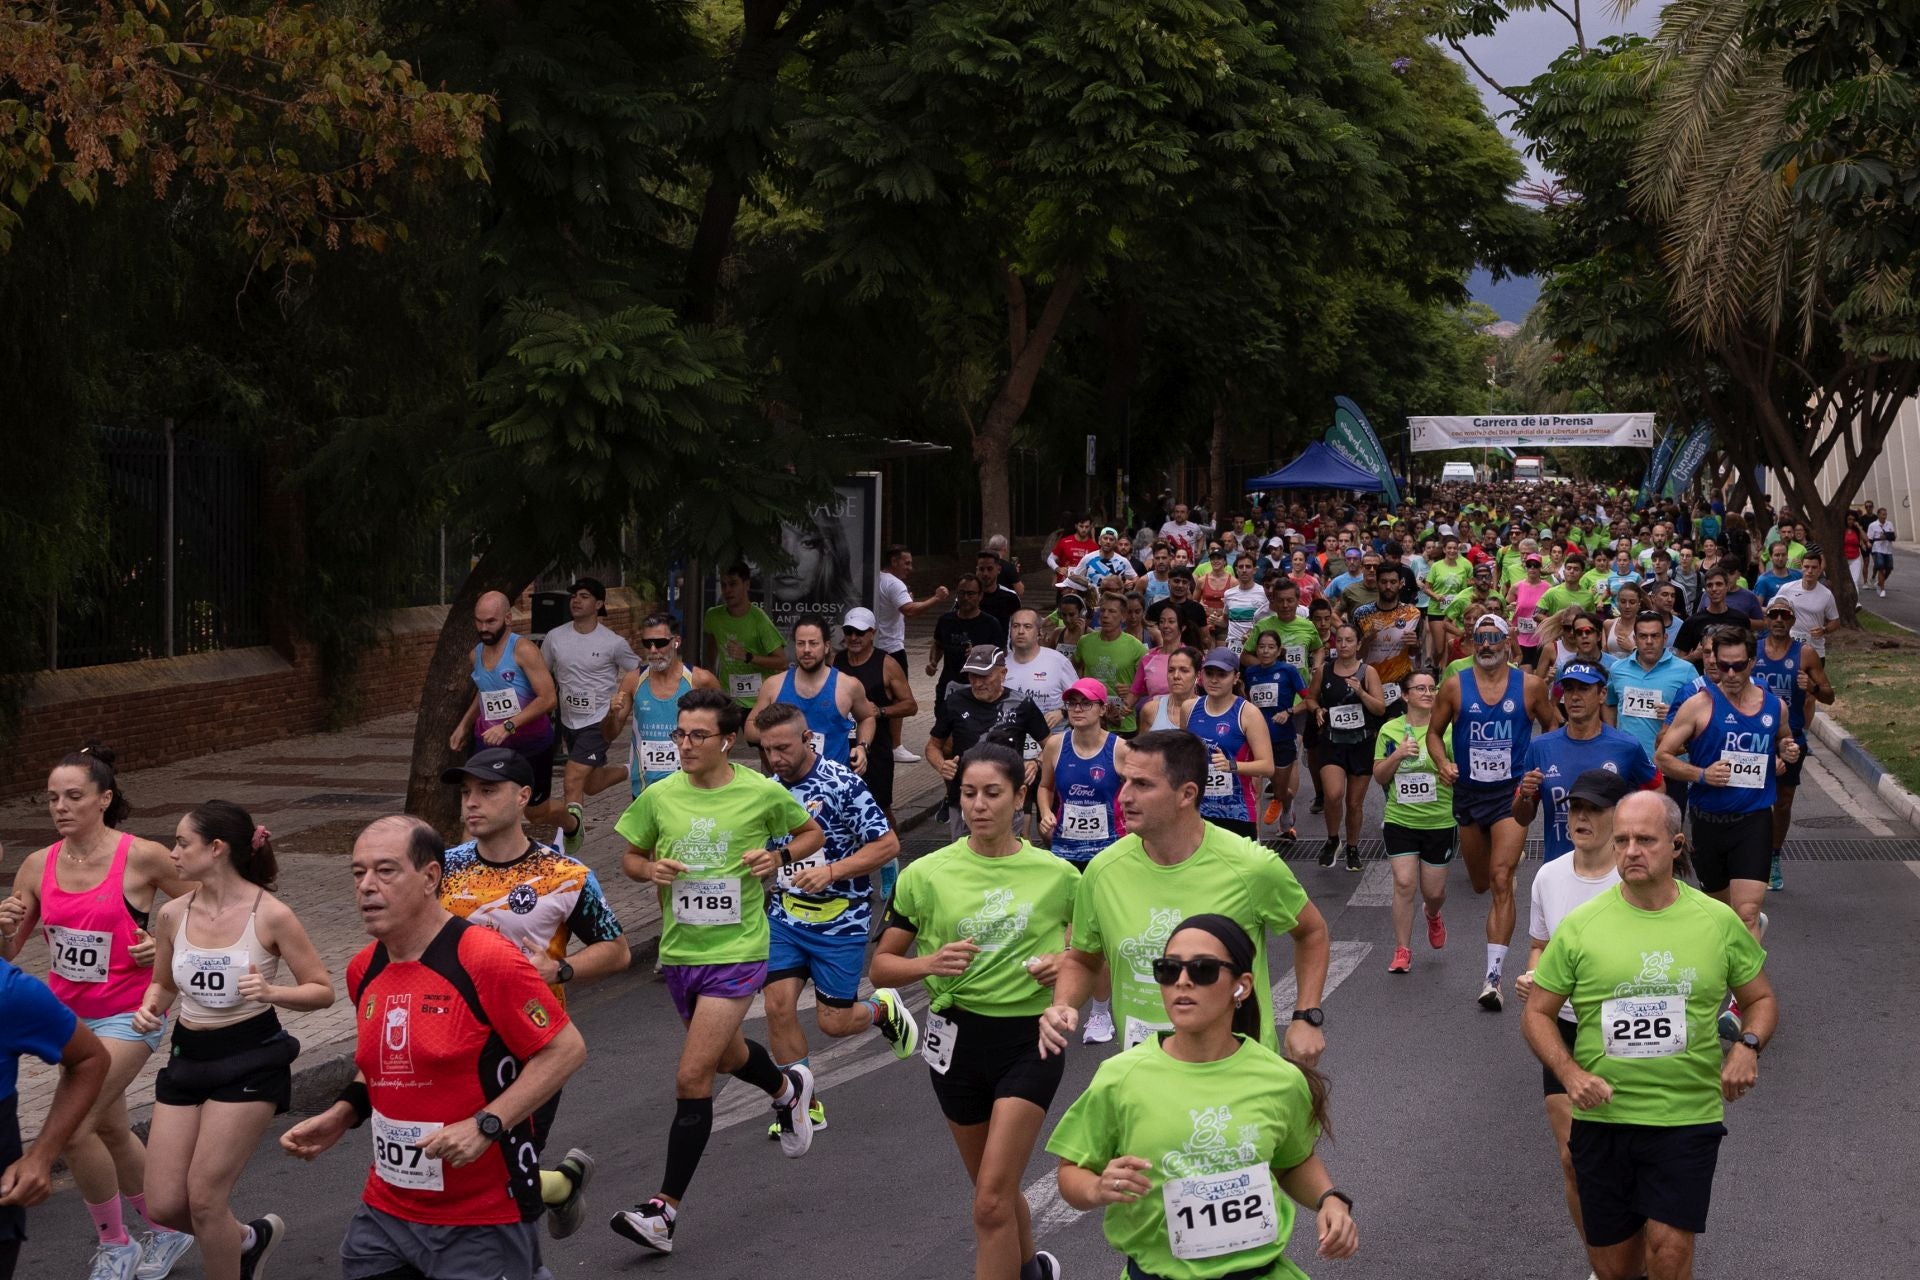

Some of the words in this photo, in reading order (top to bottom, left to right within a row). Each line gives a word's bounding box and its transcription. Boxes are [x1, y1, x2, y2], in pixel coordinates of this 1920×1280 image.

[1473, 418, 1518, 427] Carrera
[1521, 416, 1536, 426] de
[1539, 416, 1552, 426] la
[1553, 416, 1593, 426] Prensa
[1677, 443, 1706, 481] Unicaja
[795, 602, 845, 613] GLOSSY
[1287, 653, 1301, 663] 36
[1564, 664, 1590, 675] RCM
[736, 682, 752, 691] 91
[1252, 691, 1273, 702] 630
[1628, 697, 1655, 709] 715
[486, 698, 513, 712] 610
[1334, 712, 1359, 723] 435
[1470, 719, 1512, 740] RCM
[1724, 731, 1770, 753] RCM
[646, 751, 676, 763] 124
[1473, 760, 1506, 771] 1121
[1068, 783, 1096, 797] Ford
[1400, 783, 1430, 794] 890
[1068, 816, 1101, 830] 723
[679, 895, 733, 910] 1189
[56, 942, 98, 967] 740
[190, 971, 226, 991] 40
[1612, 1017, 1672, 1041] 226
[1176, 1194, 1264, 1230] 1162
